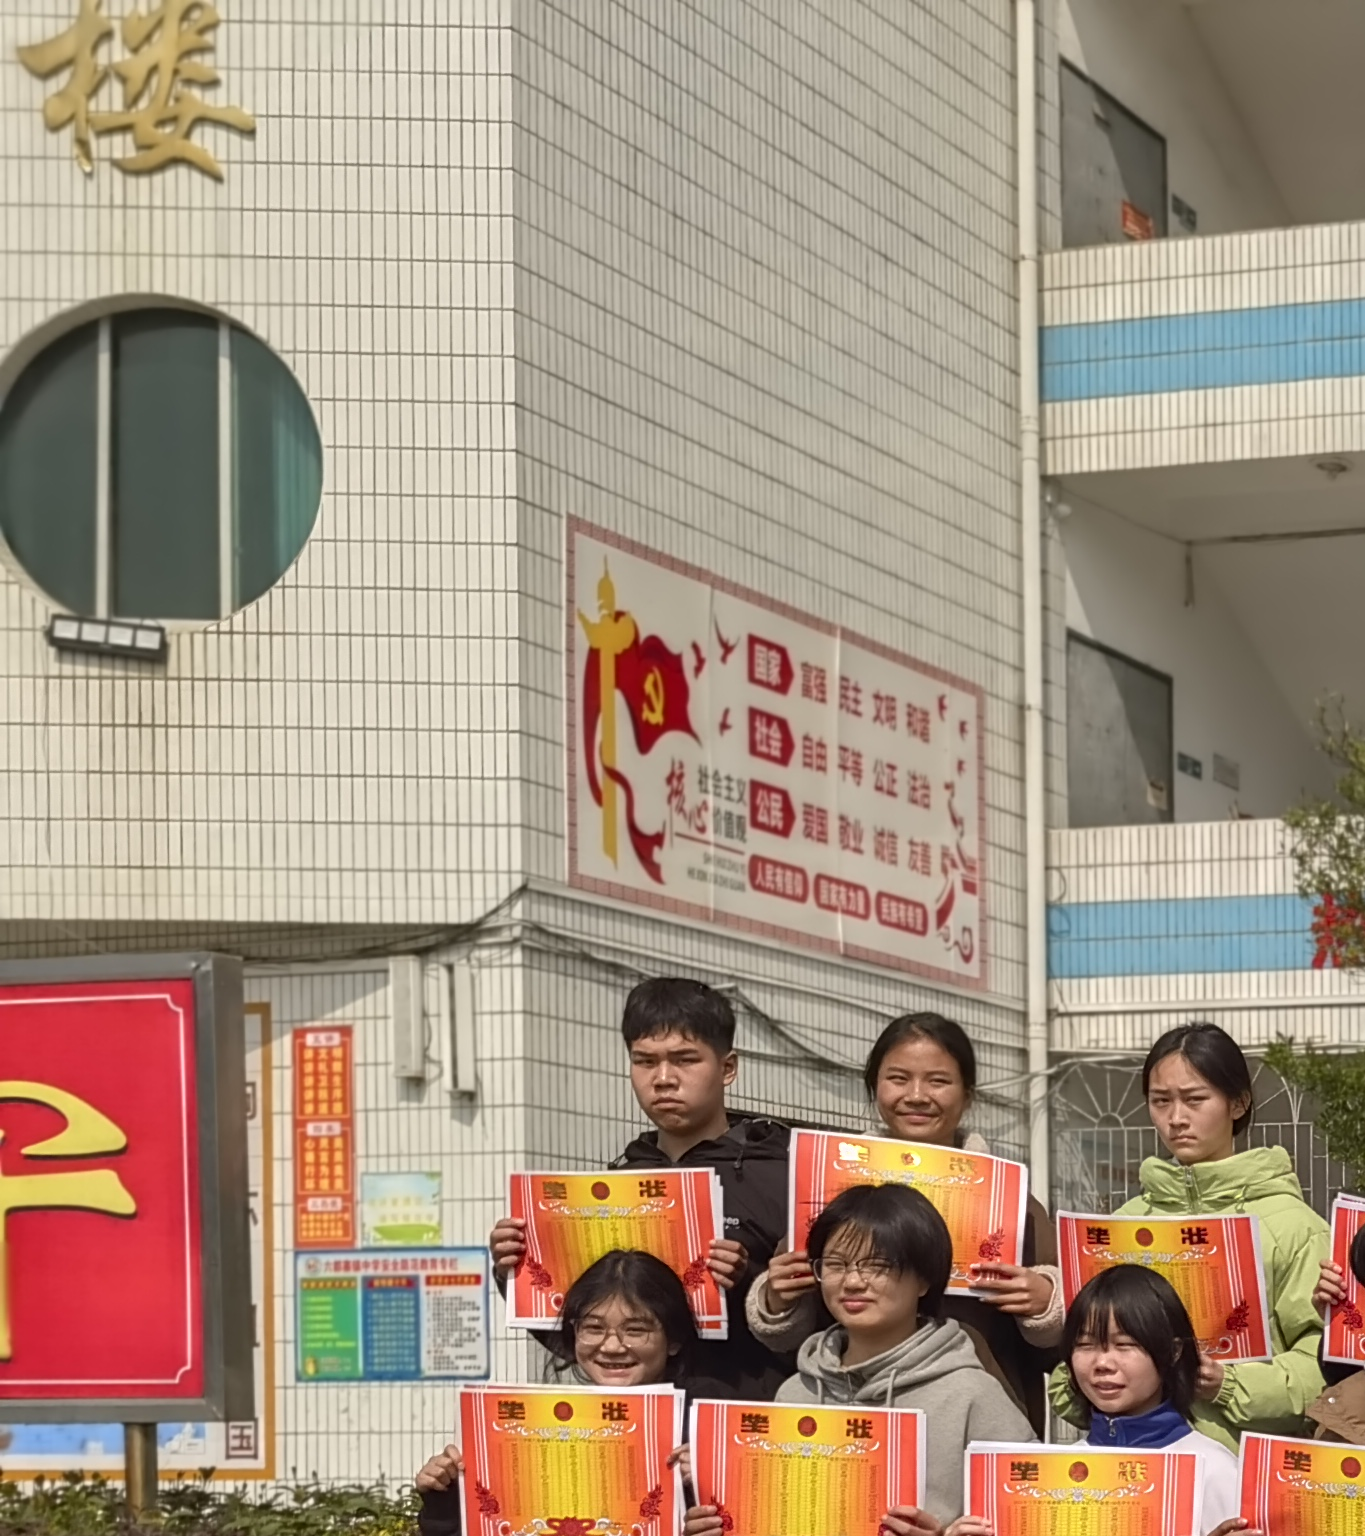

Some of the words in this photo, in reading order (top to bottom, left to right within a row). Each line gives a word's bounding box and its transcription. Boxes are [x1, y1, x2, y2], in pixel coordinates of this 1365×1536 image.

[16, 0, 257, 182] 楼
[754, 643, 781, 686] 国家
[801, 661, 827, 704] 富强
[840, 675, 862, 717] 民主
[872, 690, 897, 731] 文明
[755, 714, 782, 758] 社会
[698, 764, 746, 806] 社会主义
[802, 732, 827, 775] 自由
[838, 745, 863, 786] 平等
[872, 758, 897, 798] 公正
[907, 769, 931, 810] 法治
[756, 789, 783, 830] 公民
[802, 802, 828, 845] 爱国
[838, 814, 864, 855] 敬业
[873, 825, 898, 866] 诚信
[908, 837, 931, 877] 友善
